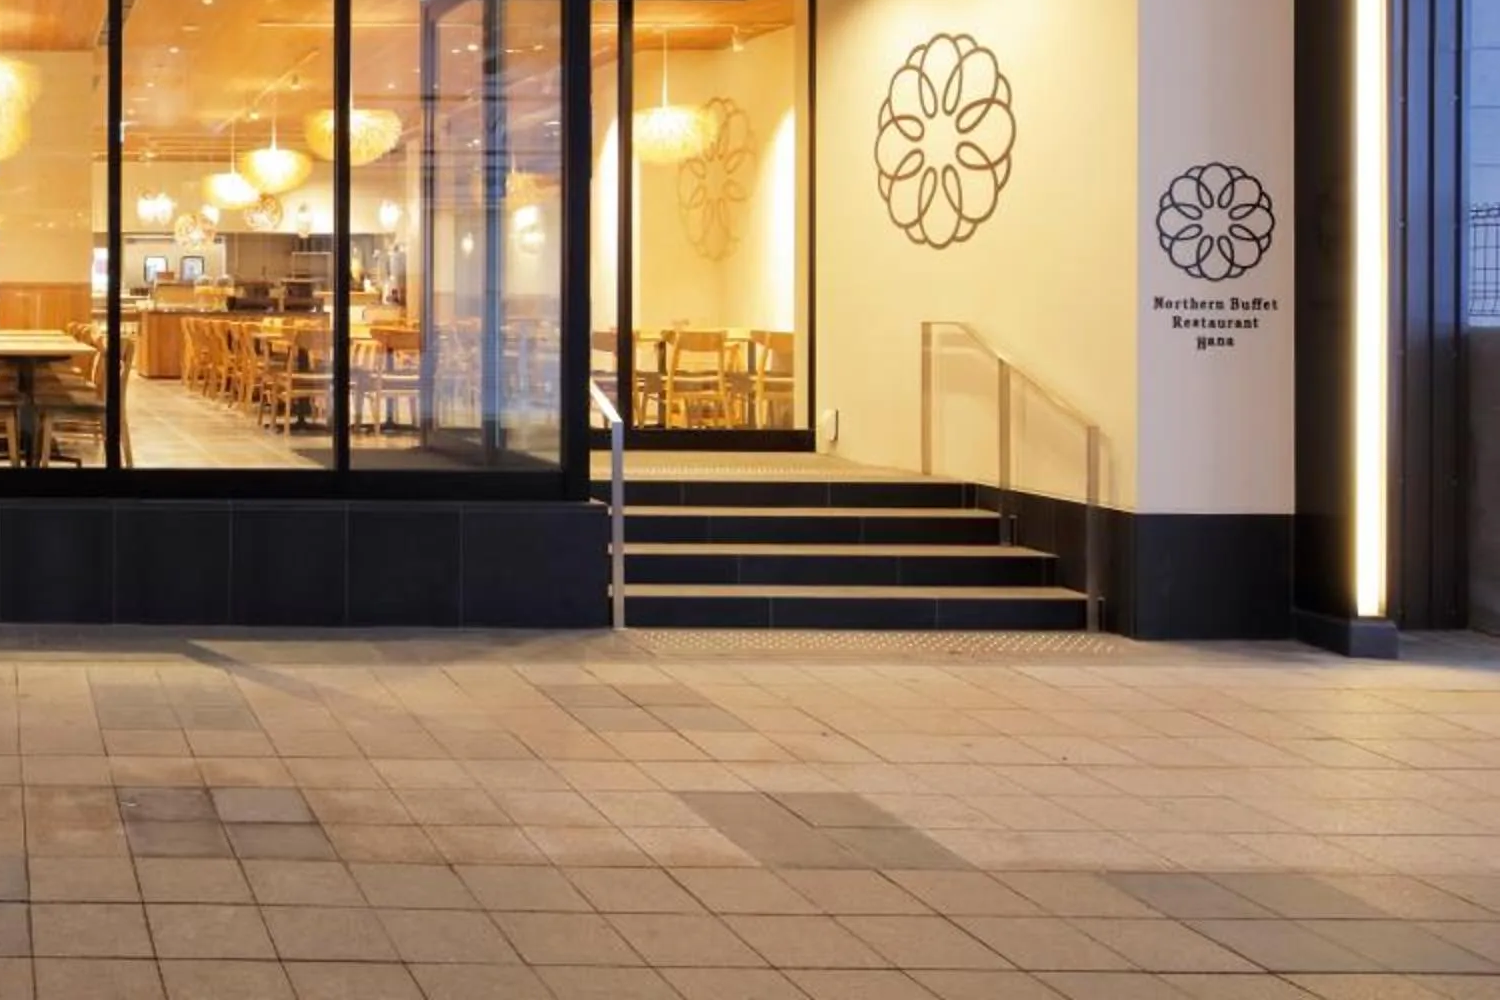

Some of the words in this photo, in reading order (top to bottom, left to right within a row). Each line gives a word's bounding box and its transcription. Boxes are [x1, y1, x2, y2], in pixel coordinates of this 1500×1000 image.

[1153, 296, 1225, 311] Northern
[1230, 296, 1279, 311] Buffet
[1172, 315, 1260, 329] Restaurant
